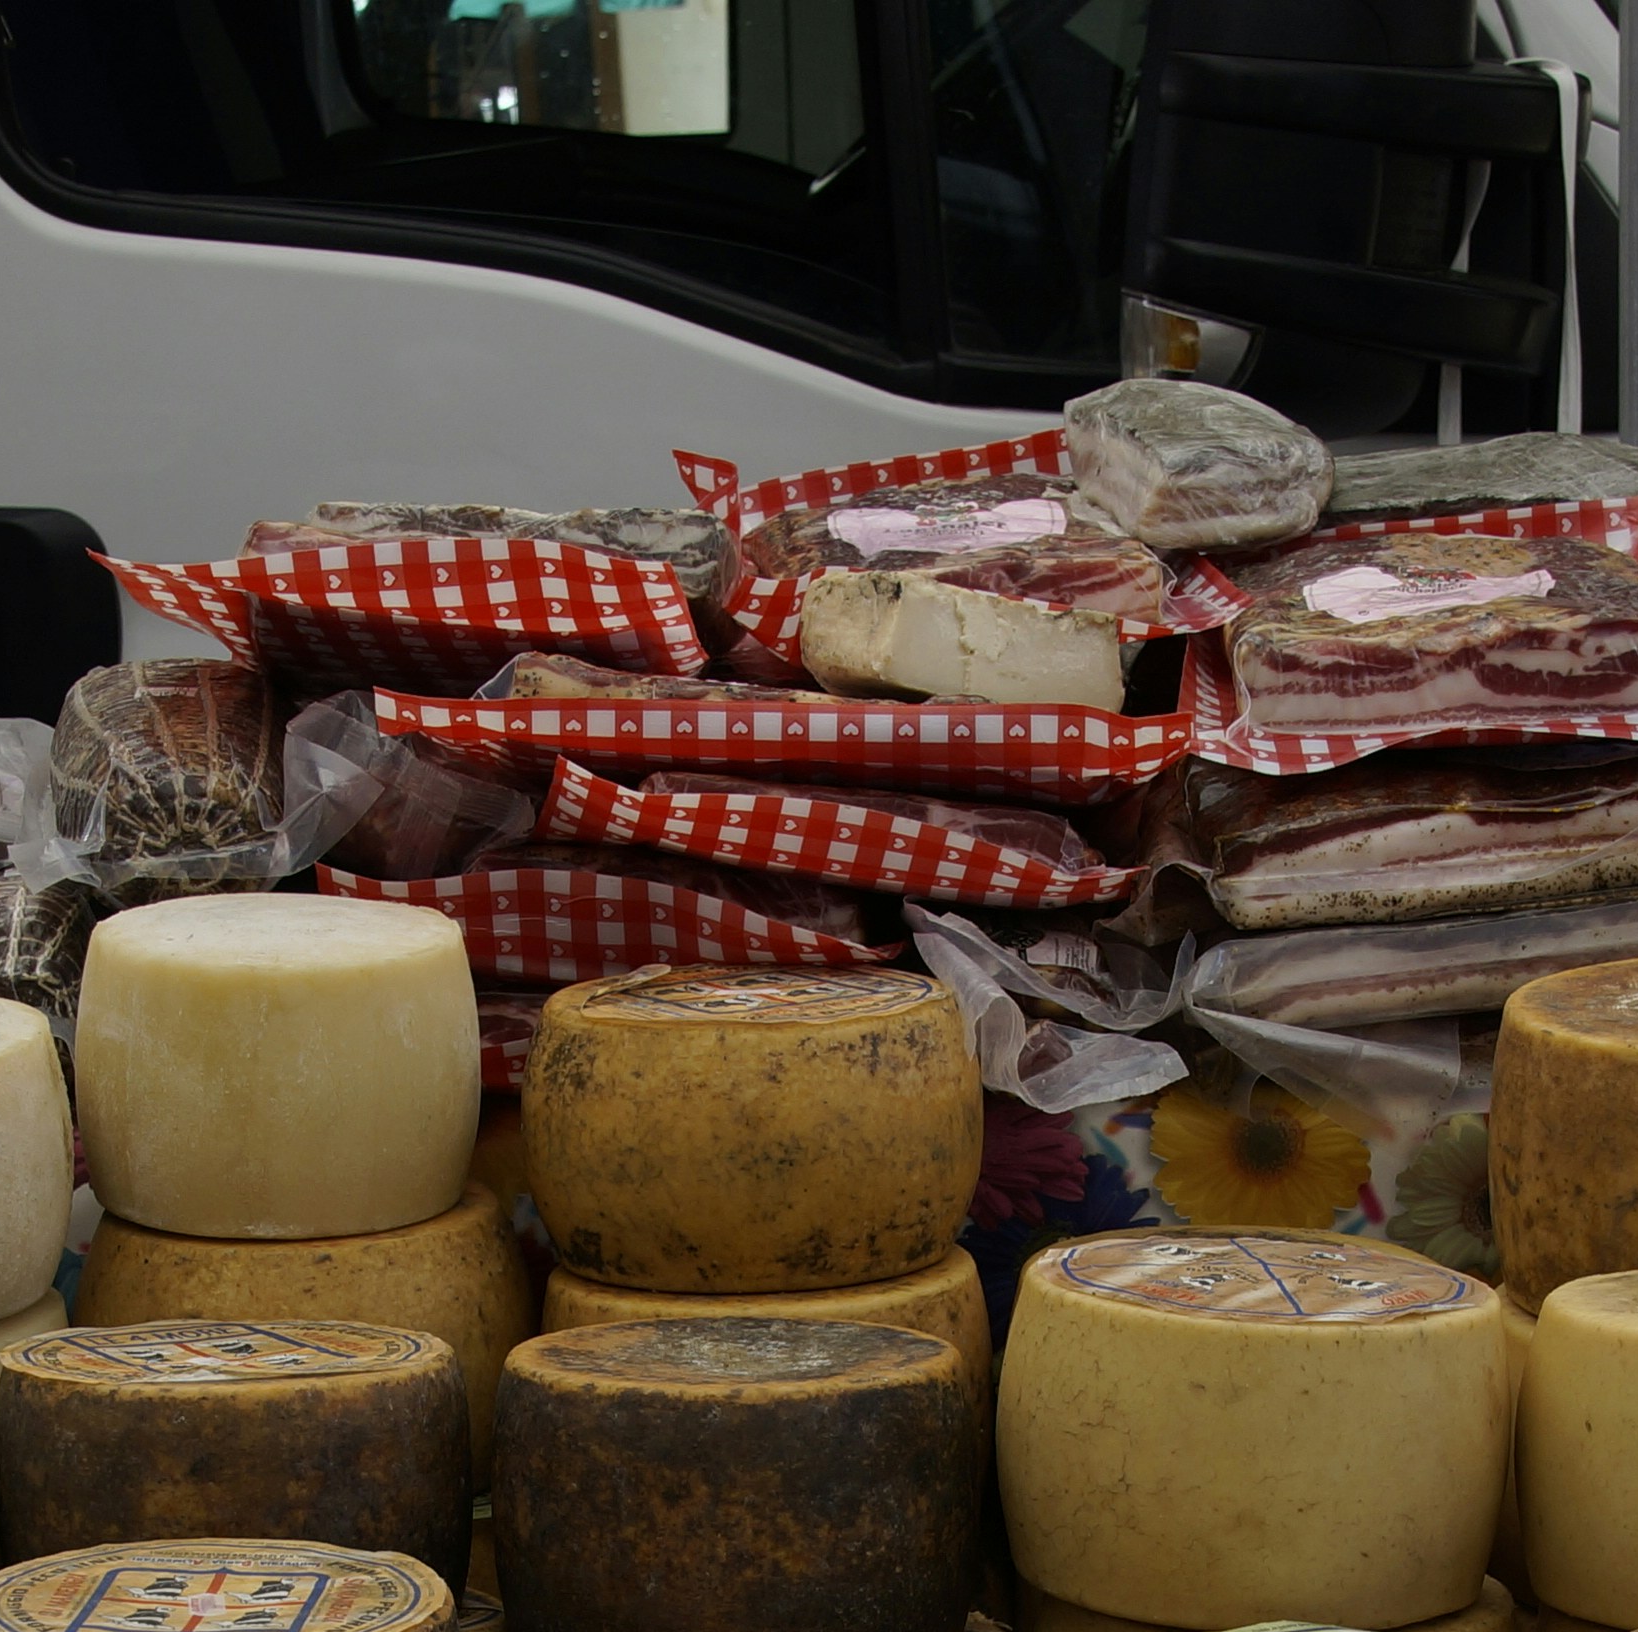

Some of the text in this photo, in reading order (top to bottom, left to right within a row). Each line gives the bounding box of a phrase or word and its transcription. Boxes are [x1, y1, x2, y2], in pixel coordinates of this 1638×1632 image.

[83, 1325, 235, 1346] LE 4 MORE
